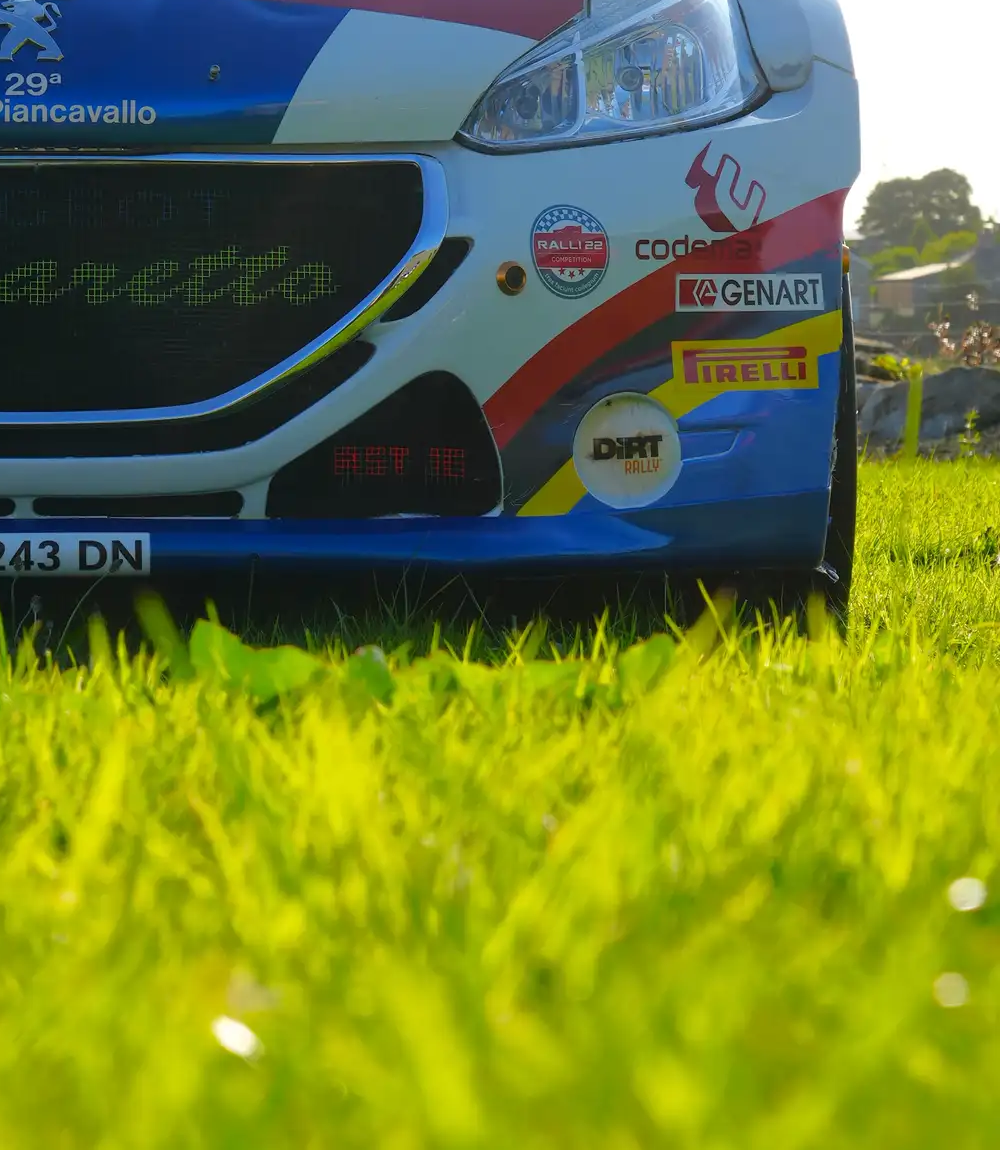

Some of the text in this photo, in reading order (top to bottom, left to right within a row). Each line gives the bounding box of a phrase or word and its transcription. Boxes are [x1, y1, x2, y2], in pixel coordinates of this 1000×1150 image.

[537, 240, 603, 250] RALLI 22
[721, 278, 820, 306] GENART
[683, 346, 808, 384] PIRELLI
[624, 459, 660, 475] RALLY
[78, 540, 144, 572] DN
